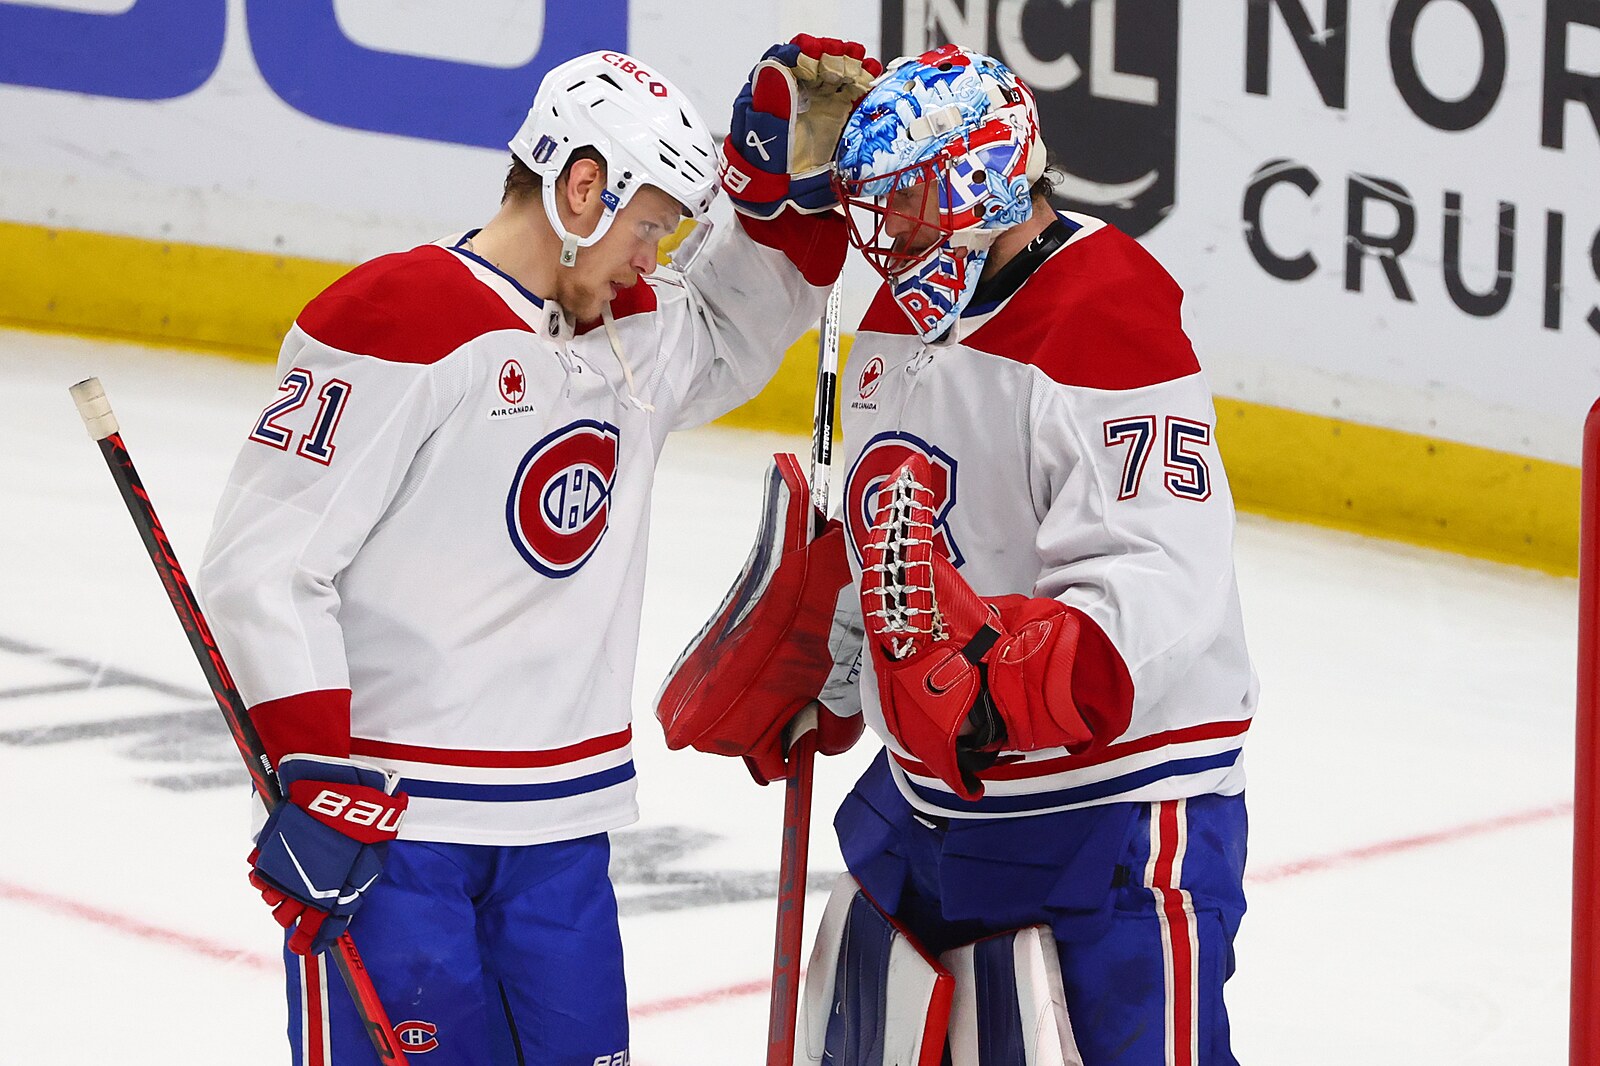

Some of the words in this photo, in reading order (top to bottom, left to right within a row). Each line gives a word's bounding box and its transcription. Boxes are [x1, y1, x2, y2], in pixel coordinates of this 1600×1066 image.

[1242, 157, 1600, 336] CRUI
[248, 367, 353, 467] 21
[1103, 415, 1212, 502] 75
